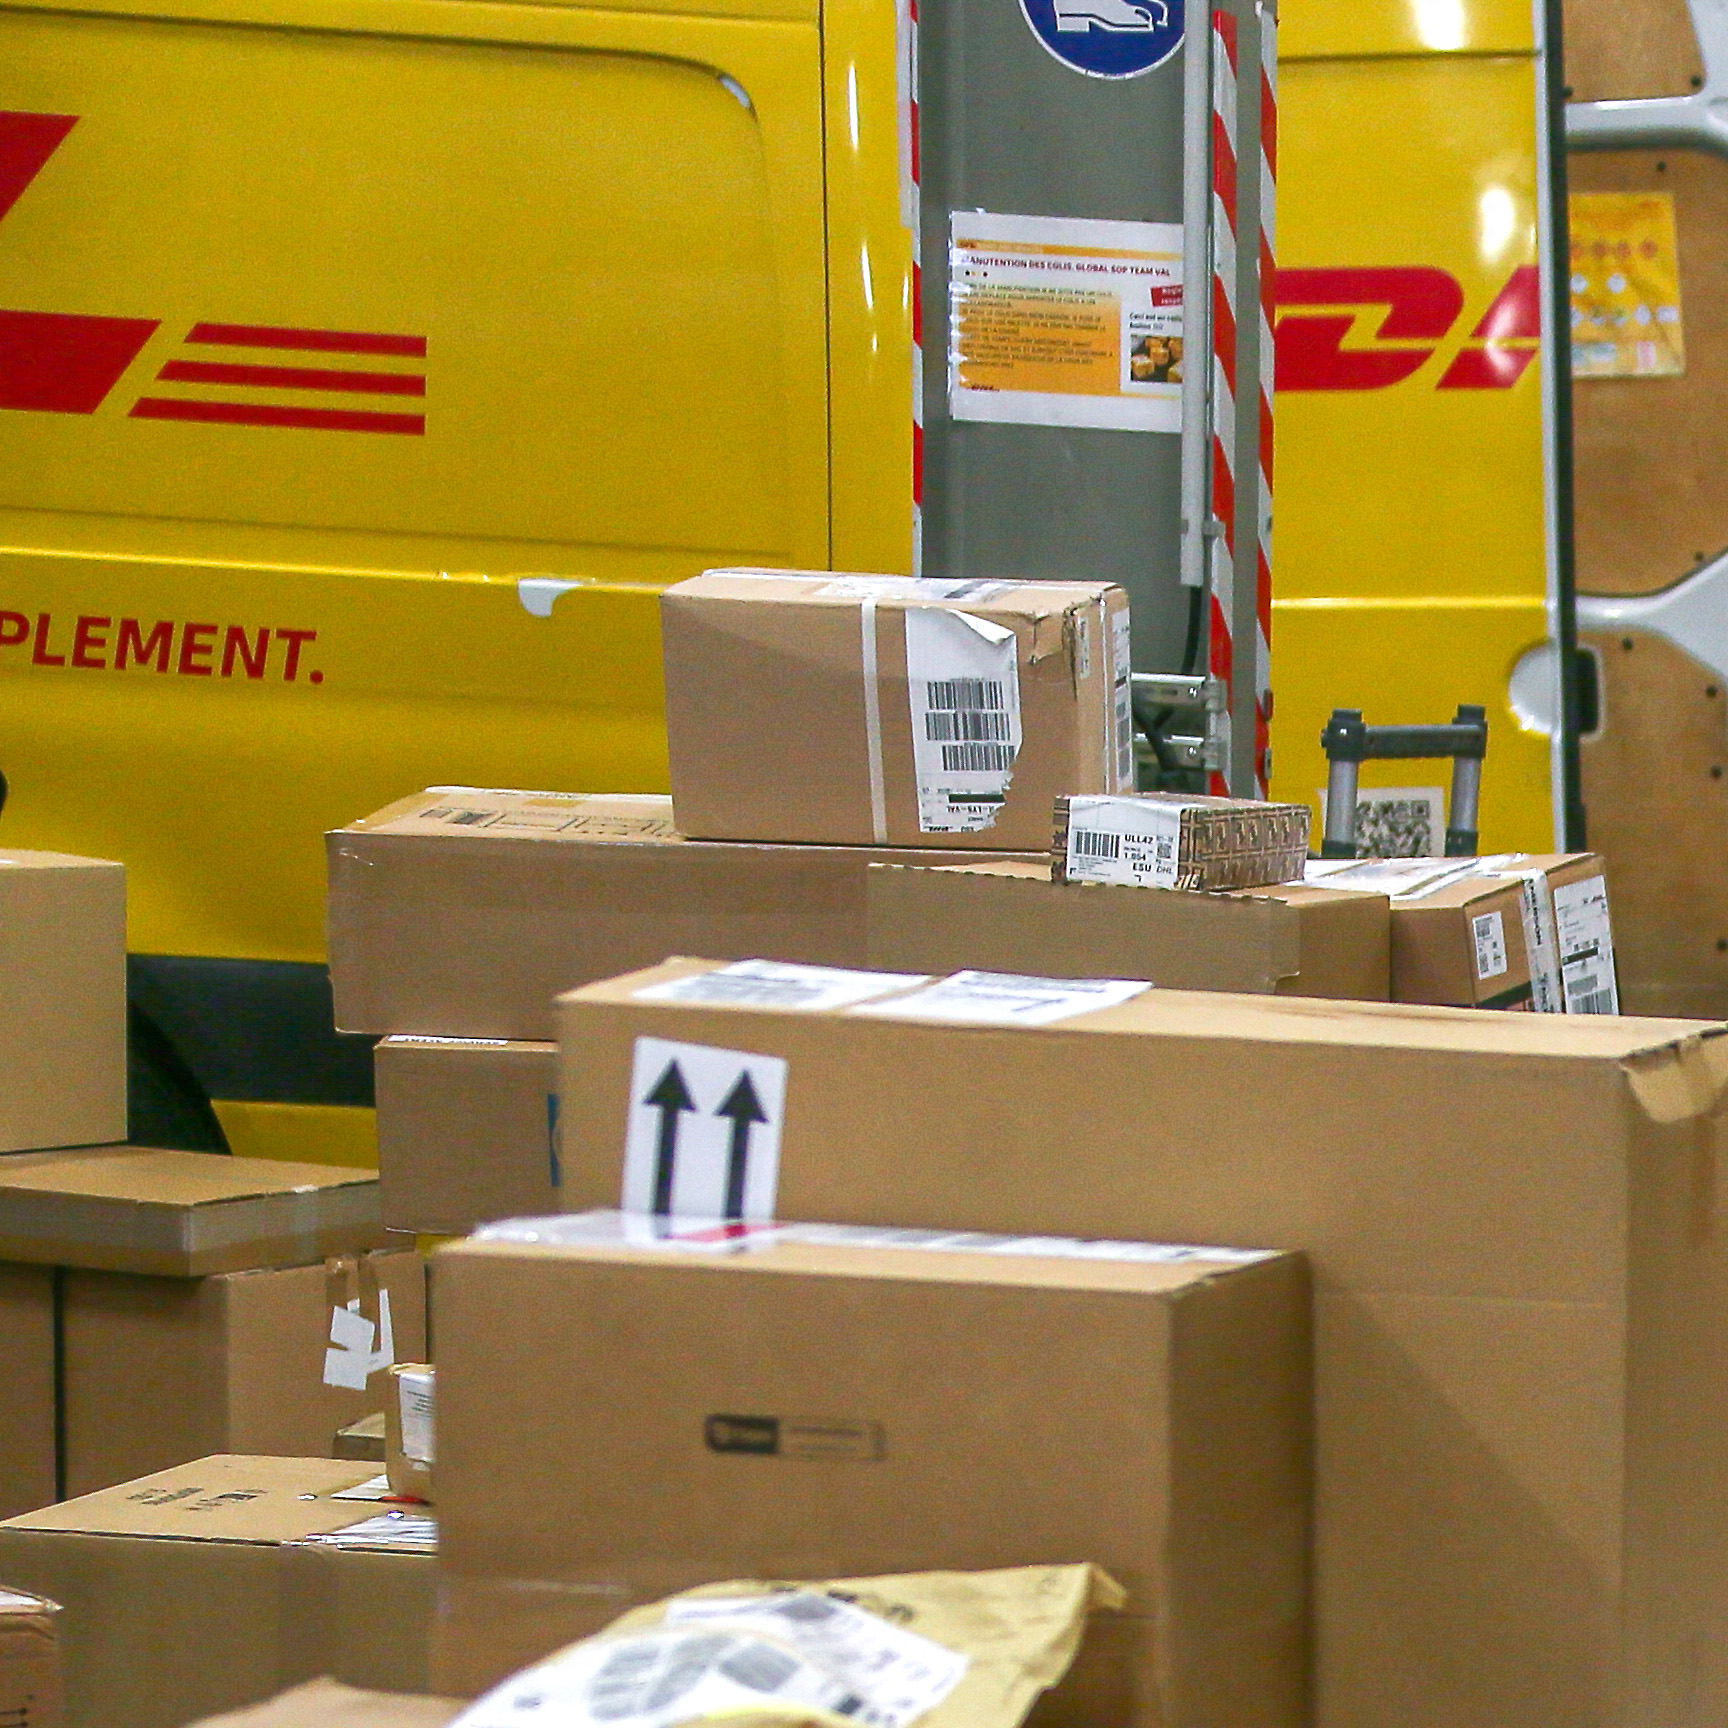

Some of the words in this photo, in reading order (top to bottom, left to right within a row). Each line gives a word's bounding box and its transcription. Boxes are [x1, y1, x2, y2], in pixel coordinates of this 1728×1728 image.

[962, 255, 1028, 269] ANUTENTION
[1129, 267, 1154, 277] TEAM
[0, 609, 325, 684] PLEMENT.
